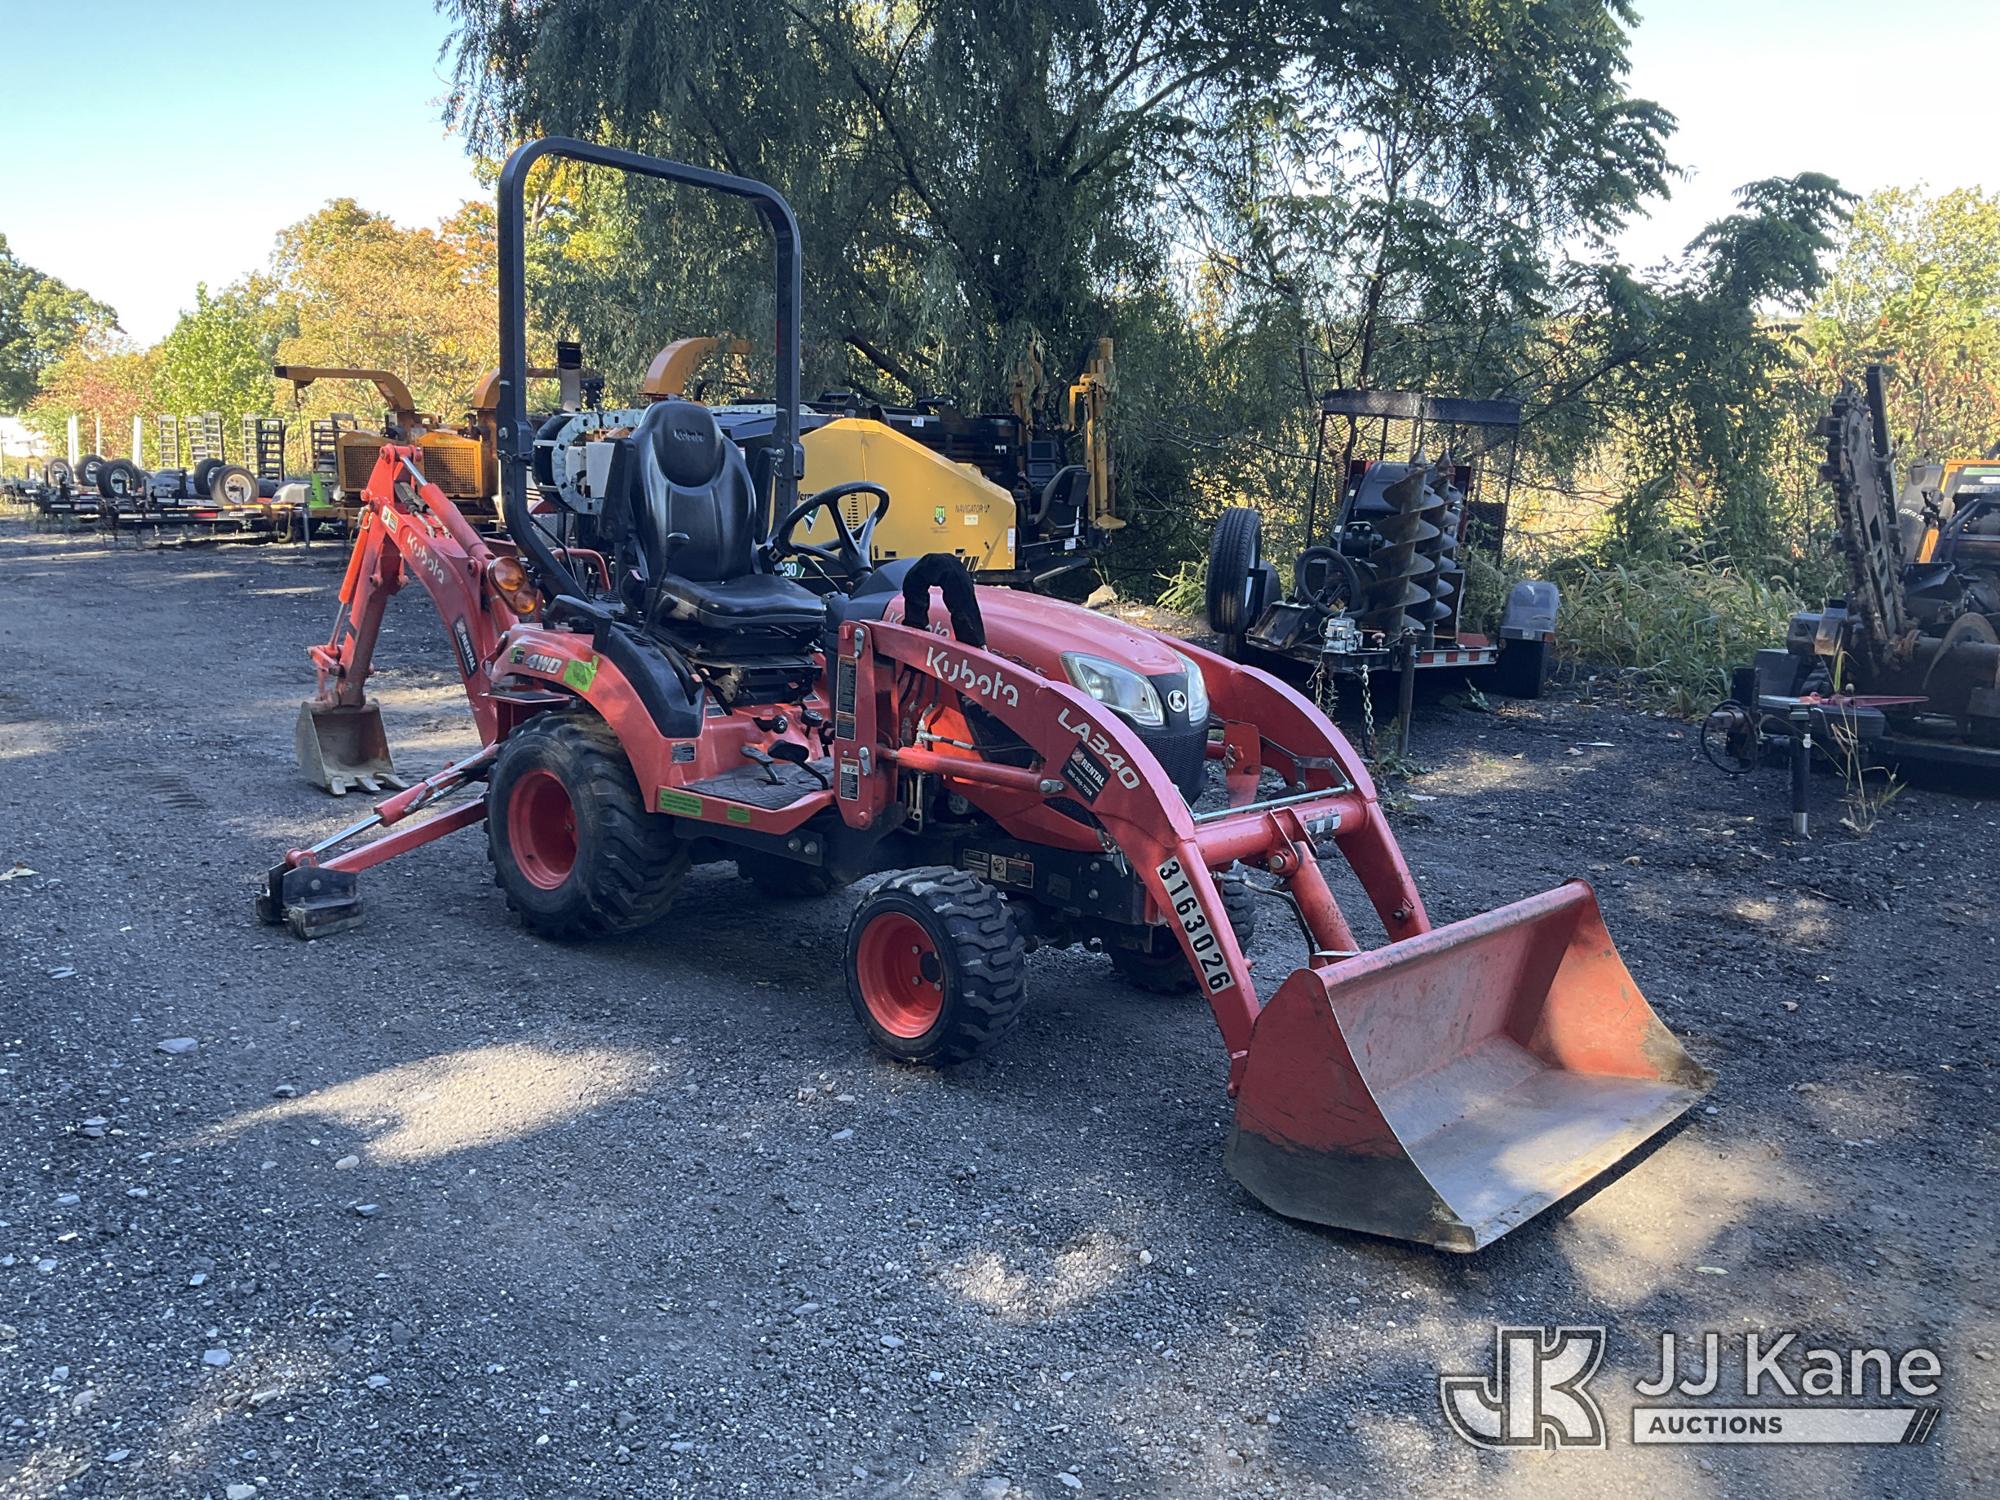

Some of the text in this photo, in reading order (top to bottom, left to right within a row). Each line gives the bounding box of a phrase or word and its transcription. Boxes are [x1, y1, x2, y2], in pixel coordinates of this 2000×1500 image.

[407, 531, 444, 585] Kubota
[460, 633, 477, 671] RENTAL
[526, 653, 563, 675] 4WD
[926, 646, 1019, 708] Kubota
[1058, 707, 1140, 790] LA340
[1081, 758, 1105, 787] RENTAL
[1159, 861, 1231, 990] 3163026
